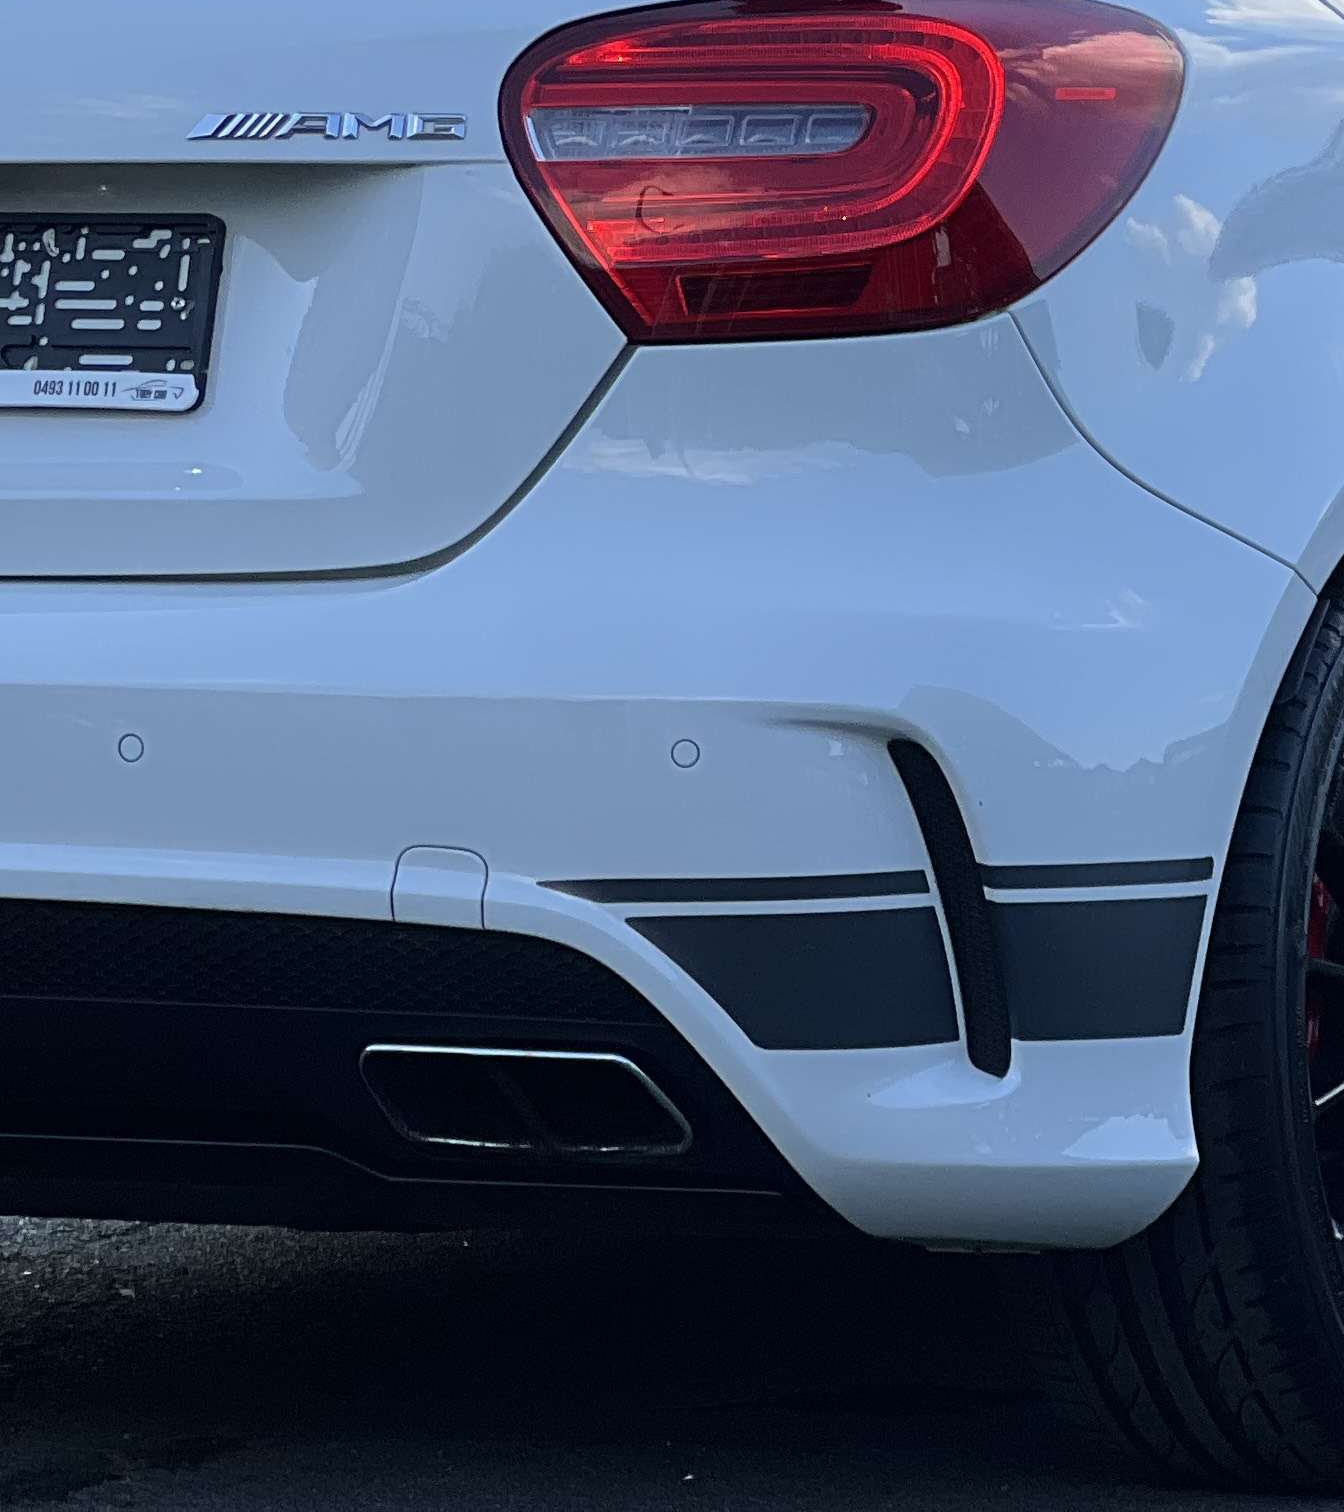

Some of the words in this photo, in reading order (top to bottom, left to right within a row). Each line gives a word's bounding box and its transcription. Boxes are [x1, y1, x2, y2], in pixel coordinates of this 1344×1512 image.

[273, 112, 467, 140] AMG
[33, 380, 63, 396] 0493
[67, 380, 81, 396] 11
[84, 381, 99, 396] 00
[103, 381, 117, 397] 11
